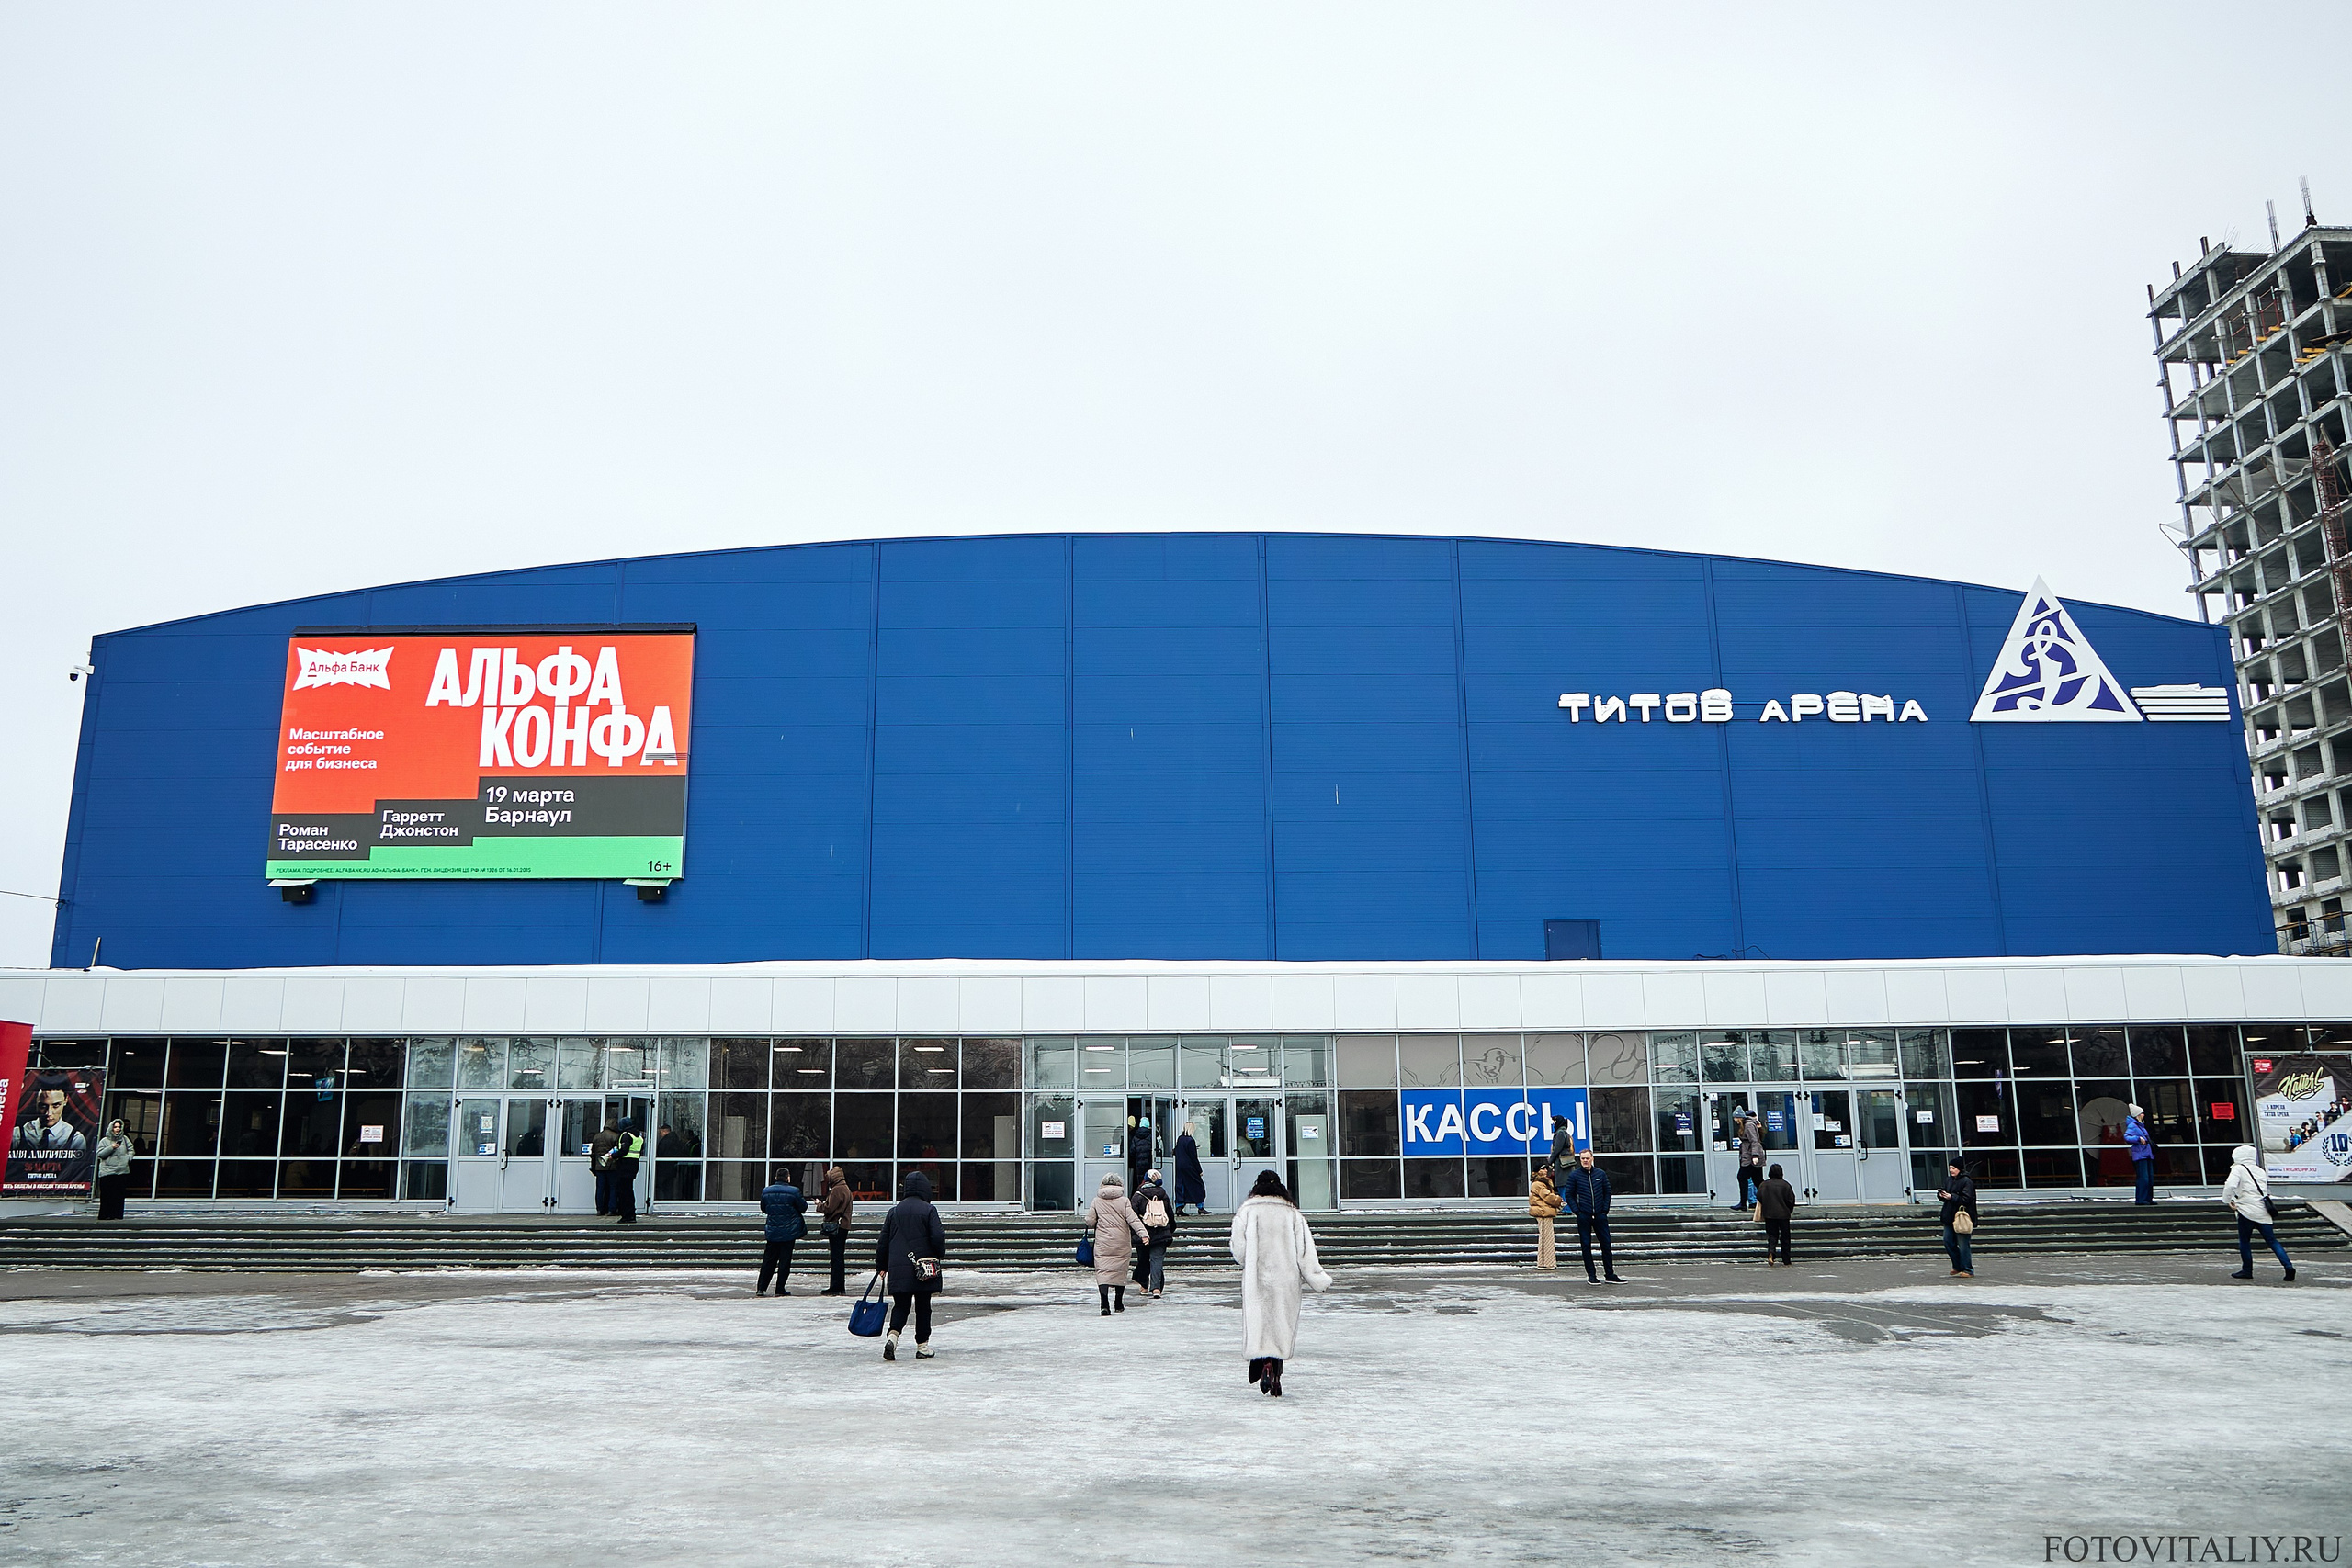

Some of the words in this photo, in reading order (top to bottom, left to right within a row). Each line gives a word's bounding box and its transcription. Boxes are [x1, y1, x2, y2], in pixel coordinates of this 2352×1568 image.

[308, 661, 347, 677] Альфа
[350, 661, 379, 672] Банк
[425, 646, 624, 707] АЛЬФА
[1558, 689, 1734, 723] ТИТОВ
[1758, 691, 1928, 723] АРЕНА
[289, 728, 384, 740] Масштабное
[479, 705, 678, 768] КОНФА
[288, 742, 351, 755] событие
[285, 760, 313, 772] для
[316, 757, 378, 769] бизнеса
[486, 786, 508, 803] 19
[512, 790, 575, 807] марта
[382, 809, 446, 825] Гарретт
[485, 807, 571, 827] Барнаул
[278, 823, 329, 837] Роман
[379, 824, 459, 839] Джонстон
[277, 837, 358, 853] Тарасенко
[647, 860, 672, 872] 16+
[1405, 1101, 1587, 1143] КАССЫ
[2330, 1133, 2349, 1152] 10
